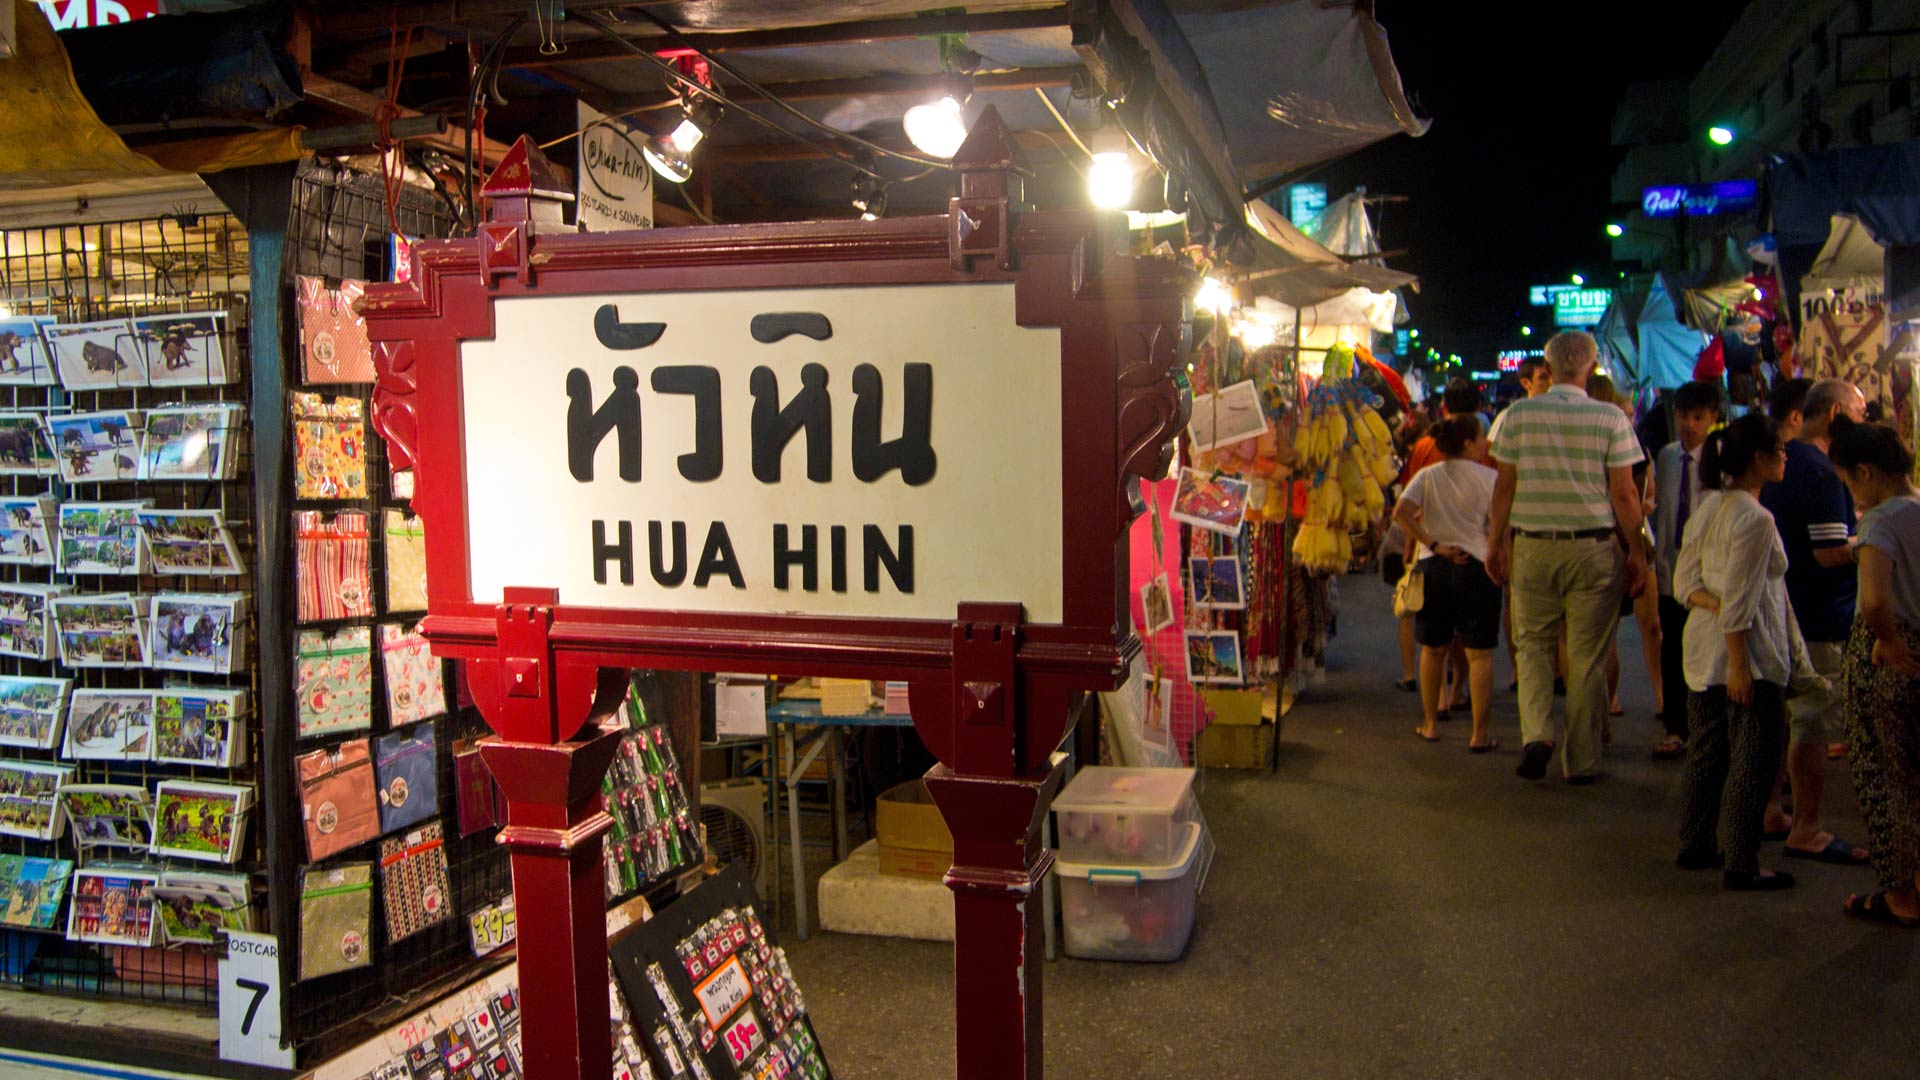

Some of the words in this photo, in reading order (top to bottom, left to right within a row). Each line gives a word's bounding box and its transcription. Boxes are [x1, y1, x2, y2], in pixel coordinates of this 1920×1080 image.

[587, 136, 643, 181] @hua-hin
[565, 303, 938, 487] หัวหิน
[591, 519, 747, 589] HUA
[772, 523, 915, 594] HIN
[227, 938, 278, 958] OSTCAR
[235, 977, 270, 1036] 7
